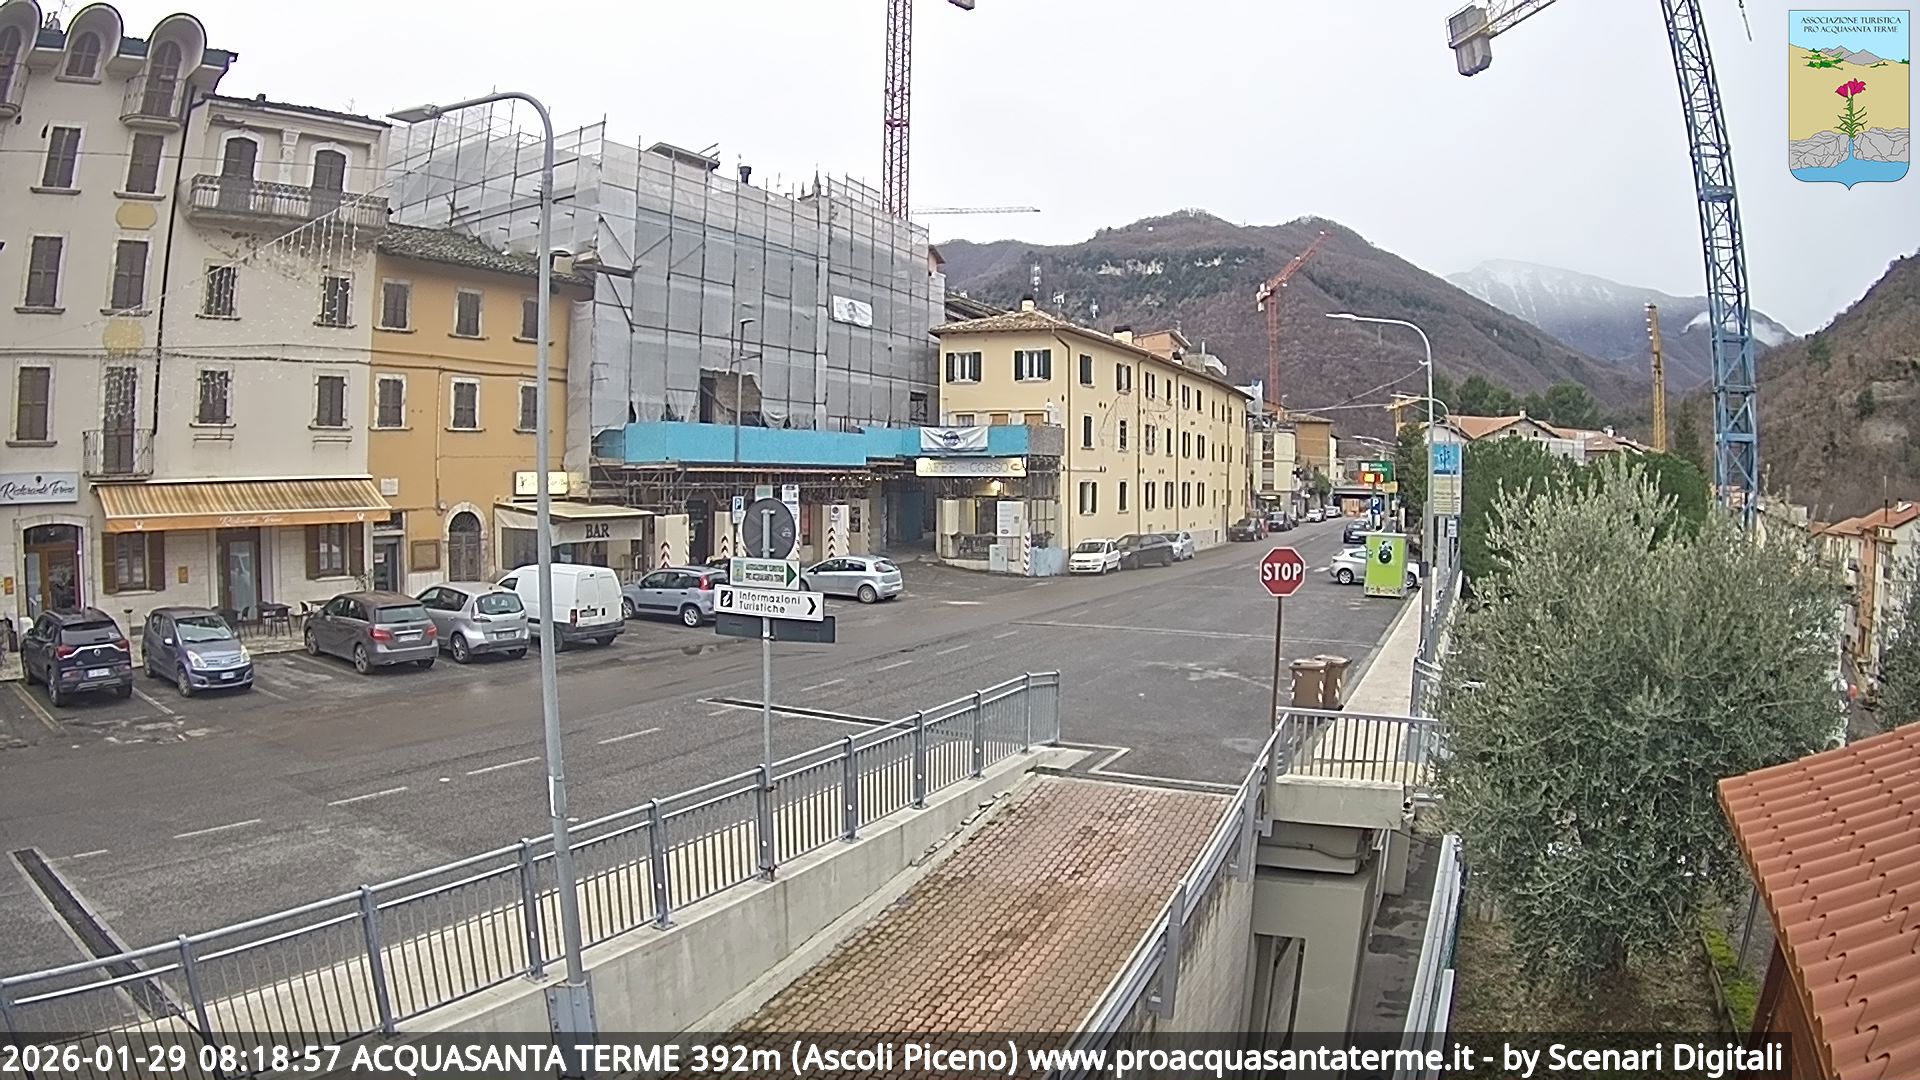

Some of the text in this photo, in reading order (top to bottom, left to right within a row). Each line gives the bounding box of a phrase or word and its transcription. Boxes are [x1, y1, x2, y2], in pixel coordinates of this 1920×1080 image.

[969, 461, 1009, 474] CORSO
[585, 522, 610, 539] BAR
[1263, 562, 1302, 581] STOP
[739, 590, 801, 606] Informazioni
[739, 601, 786, 614] Turistiche
